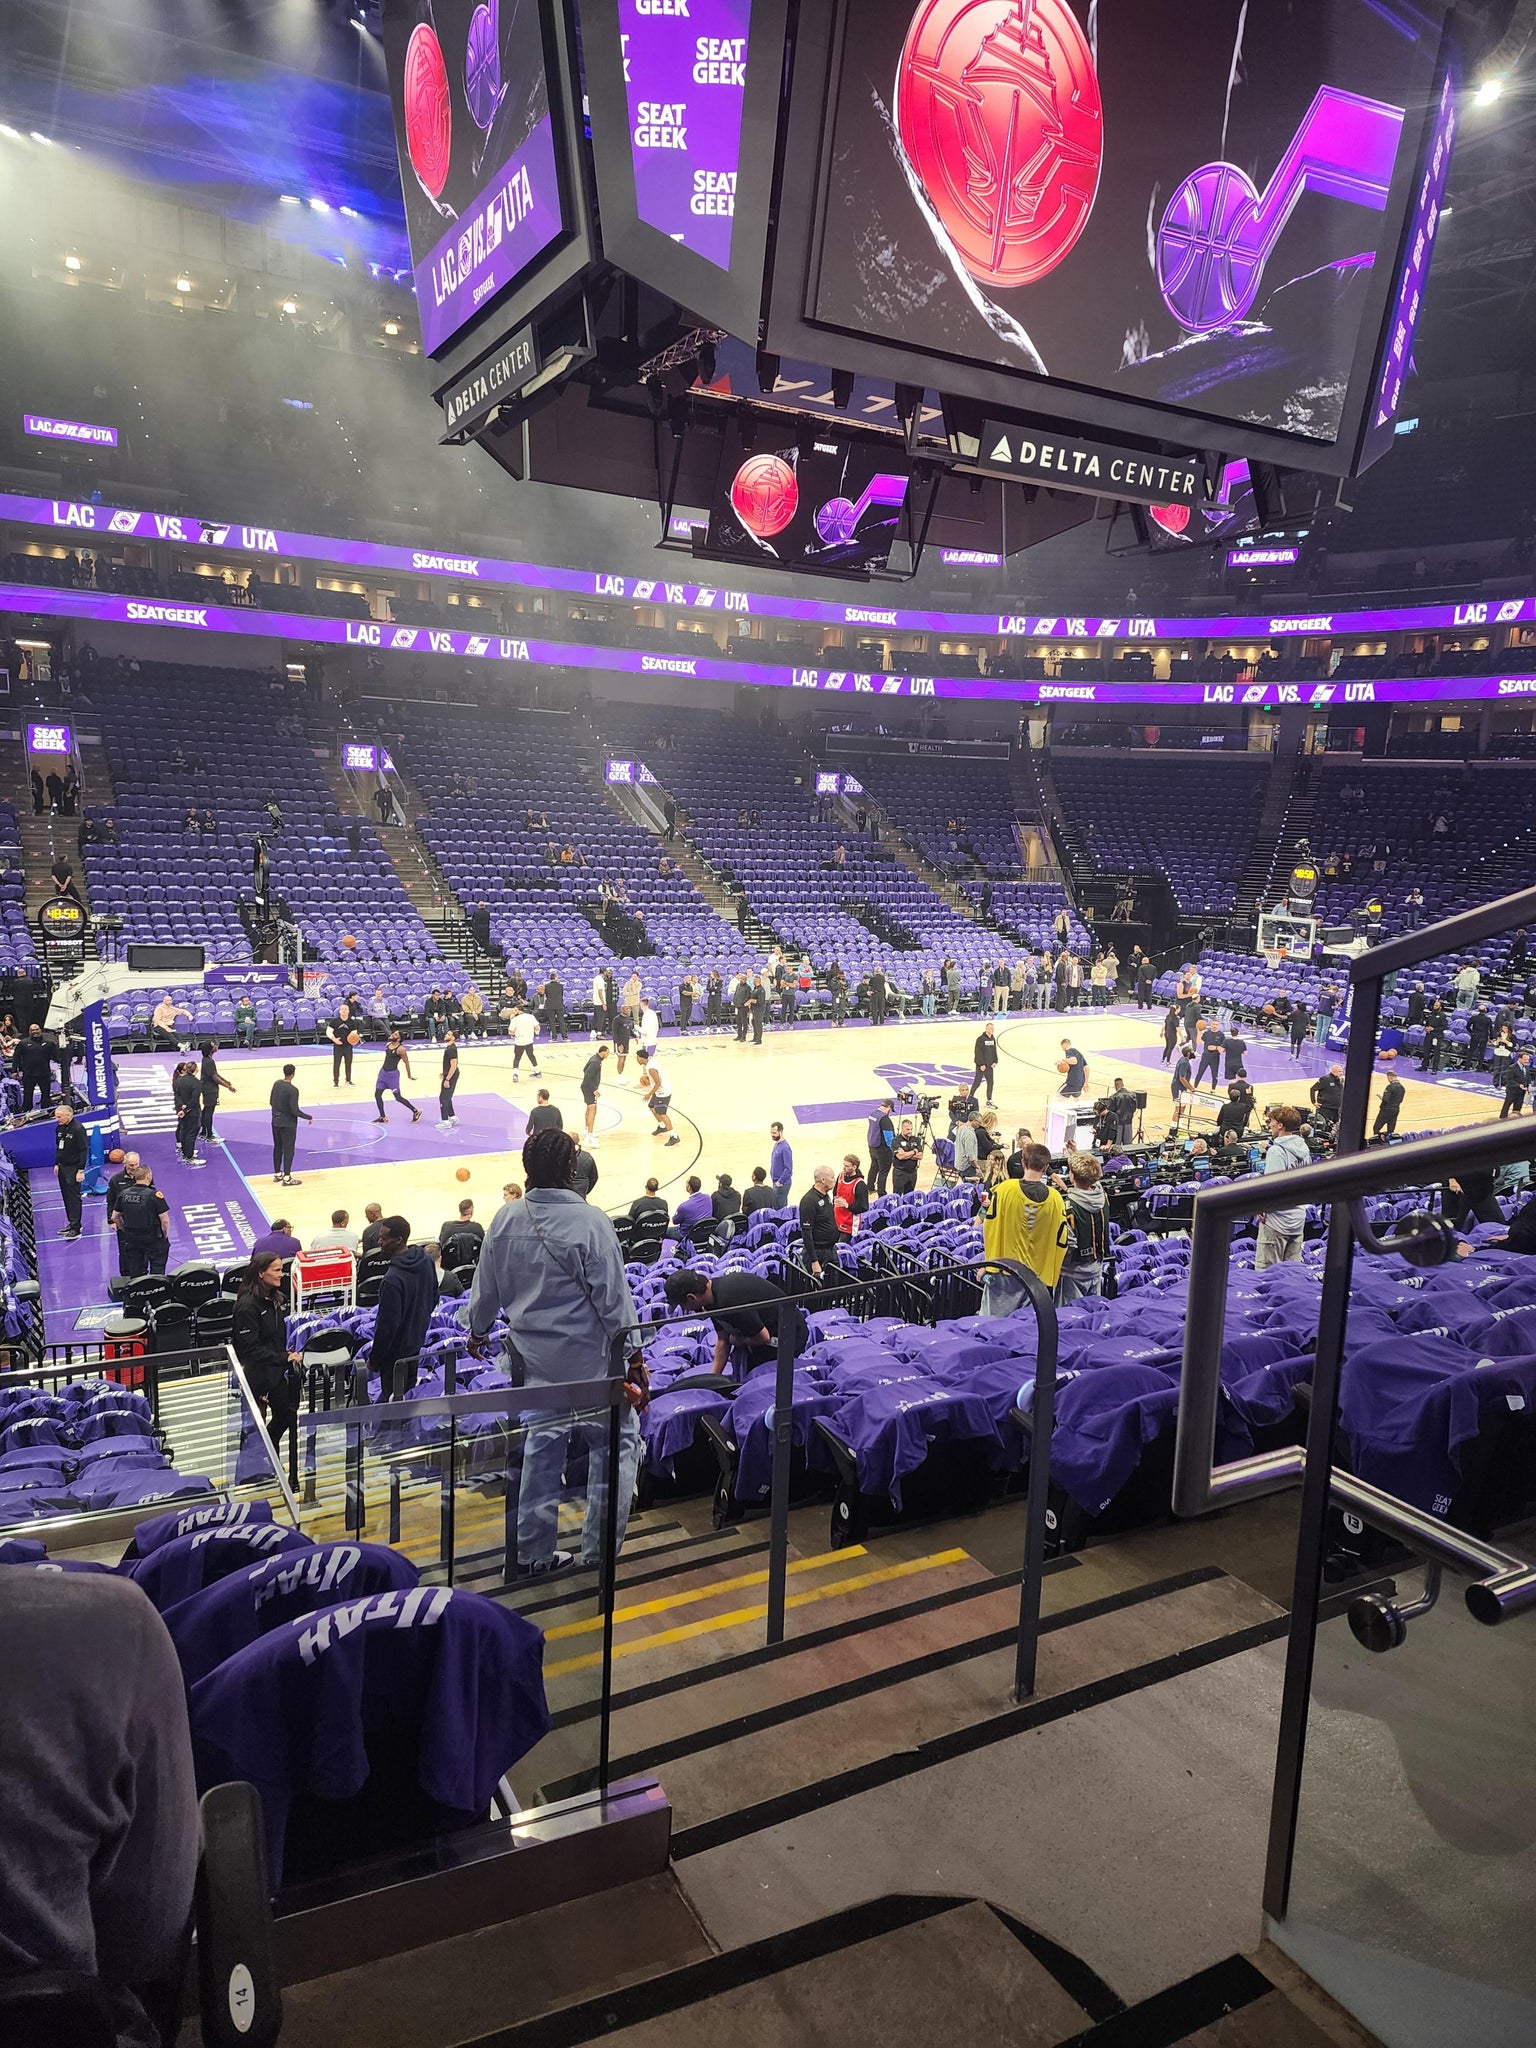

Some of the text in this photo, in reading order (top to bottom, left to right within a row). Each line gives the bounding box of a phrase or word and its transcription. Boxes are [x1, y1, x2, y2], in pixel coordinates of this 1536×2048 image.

[635, 0, 690, 17] GEEK
[696, 37, 745, 62] SEAT
[693, 61, 747, 86] GEEK
[637, 101, 687, 126] SEAT
[634, 125, 687, 150] GEEK
[432, 247, 457, 307] LAC
[502, 164, 534, 232] UTA
[473, 271, 495, 305] SEATGEEK
[455, 341, 531, 417] DELTA CENTER
[30, 418, 52, 433] LAC
[93, 429, 113, 442] UTA
[1020, 441, 1196, 495] DELTA CENTER
[53, 502, 279, 552] LAC VS. UTA
[412, 553, 479, 576] SEATGEEK
[595, 574, 749, 612] LAC VS. UTA
[126, 602, 208, 627] SEATGEEK
[845, 608, 897, 626] SEATGEEK
[1269, 617, 1332, 633] SEATGEEK
[1454, 604, 1488, 626] LAC
[998, 616, 1156, 637] LAC VS. UTA
[346, 623, 530, 660] LAC VS. UTA
[642, 656, 696, 675] SEATGEEK
[792, 669, 935, 696] LAC VS. UTA
[1039, 685, 1096, 699] SEATGEEK
[1203, 683, 1375, 702] LAC VS. UTA
[1498, 679, 1536, 694] SEATG
[33, 727, 65, 740] SEAT
[32, 739, 67, 751] GEEK
[347, 746, 373, 757] SEAT
[919, 744, 943, 752] HEALTH
[347, 757, 374, 768] GEEK
[610, 762, 631, 772] SEAT
[92, 1021, 108, 1099] AMERICA FIRST
[181, 1203, 237, 1255] HEALTH
[1431, 1502, 1449, 1515] GEEK
[1434, 1494, 1453, 1506] SEAT
[177, 1502, 251, 1536] UTAH
[1046, 1513, 1055, 1526] 12
[1347, 1514, 1360, 1530] 13
[254, 1546, 361, 1611] UTAH
[297, 1586, 454, 1667] UTAH
[235, 1988, 249, 2007] 14
